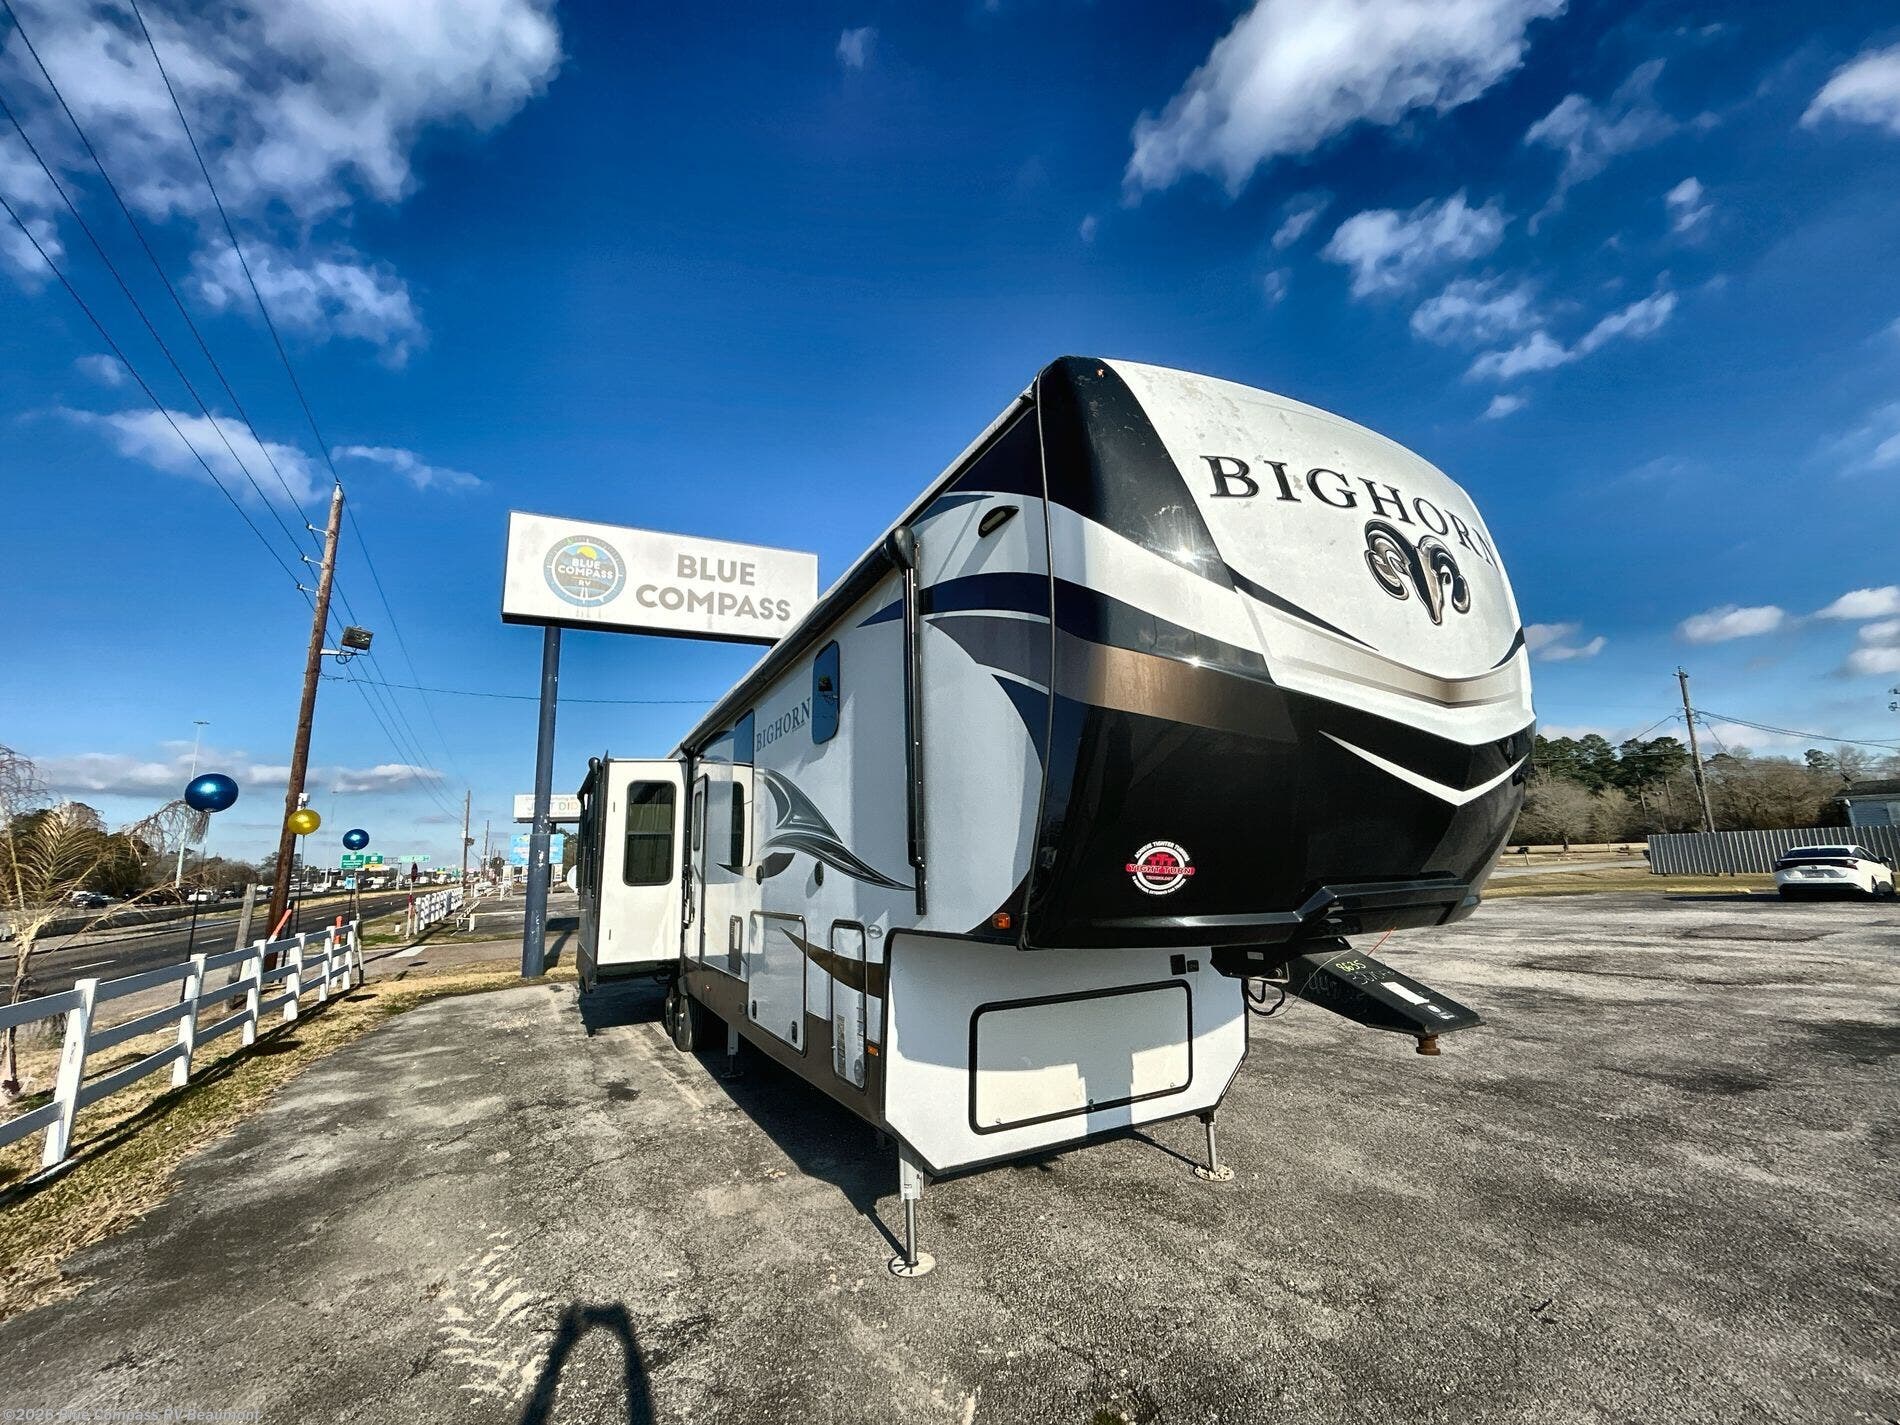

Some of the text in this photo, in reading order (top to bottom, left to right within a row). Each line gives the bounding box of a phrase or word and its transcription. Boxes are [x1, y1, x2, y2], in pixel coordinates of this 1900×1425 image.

[1200, 455, 1501, 576] BIGHORN
[557, 565, 614, 579] COMPASS
[572, 558, 600, 569] BLUE
[677, 554, 756, 586] BLUE
[635, 584, 791, 622] COMPASS
[755, 697, 811, 752] BIGHORN
[1129, 864, 1192, 875] TIGHT TURN
